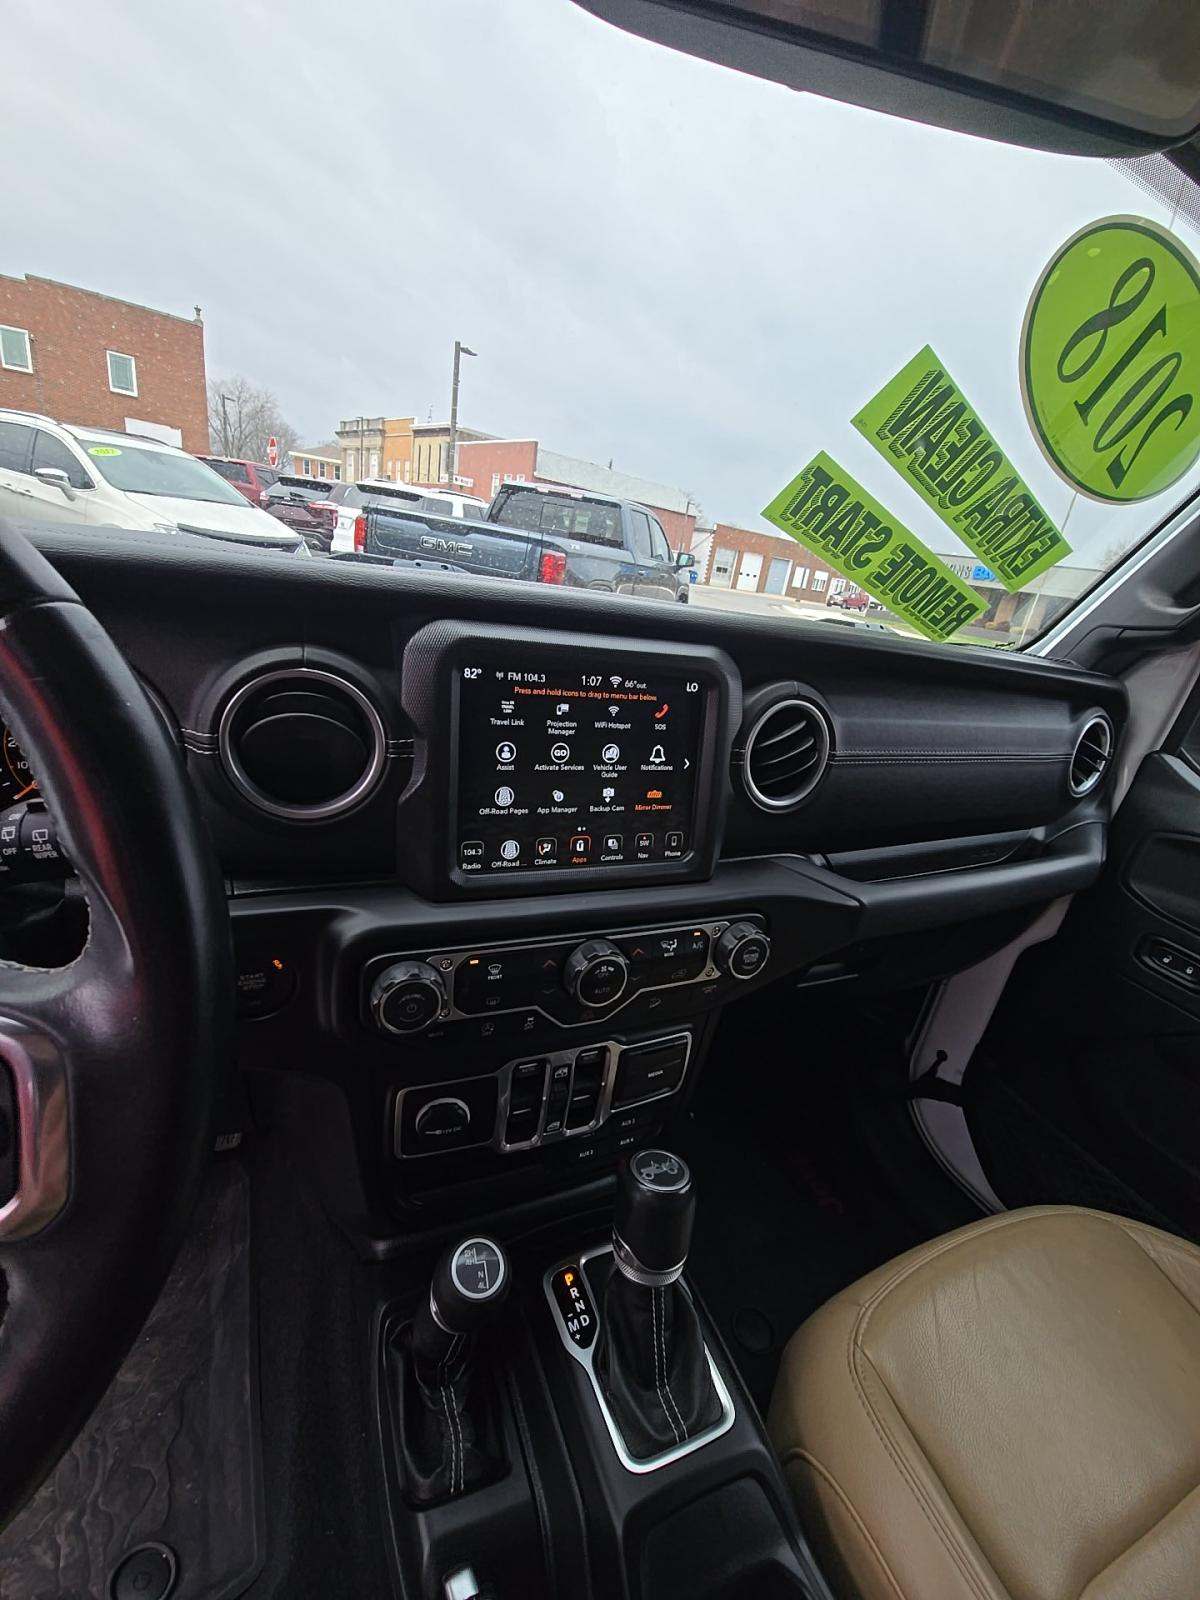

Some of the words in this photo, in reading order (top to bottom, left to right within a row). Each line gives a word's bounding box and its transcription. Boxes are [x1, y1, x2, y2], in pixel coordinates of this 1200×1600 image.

[419, 535, 473, 557] GMC
[507, 671, 521, 681] FM
[523, 673, 546, 683] 104.3
[581, 675, 603, 686] 1:07
[686, 682, 699, 692] LO
[514, 686, 531, 695] Press
[532, 688, 545, 696] and
[547, 688, 561, 696] hold
[562, 689, 579, 697] icons
[587, 691, 602, 700] drag
[629, 692, 638, 700] bar
[490, 717, 510, 726] Travel
[511, 718, 525, 726] Link
[546, 720, 577, 729] Projection
[608, 721, 631, 730] Hotspot
[654, 723, 667, 731] SOS
[547, 728, 576, 737] Manager
[553, 749, 567, 757] GO
[601, 771, 618, 779] Guide
[509, 807, 529, 816] Pages
[536, 807, 550, 815] App
[551, 806, 578, 814] Manager
[589, 805, 610, 813] Backup
[2, 847, 17, 856] OFF
[31, 843, 53, 852] REAR
[572, 856, 587, 864] Apps
[600, 853, 624, 861] Controls
[462, 862, 482, 870] Radio
[477, 1270, 484, 1278] N
[564, 1272, 574, 1286] P
[570, 1287, 580, 1299] R
[575, 1299, 586, 1313] N
[580, 1314, 590, 1327] D
[568, 1318, 580, 1333] M
